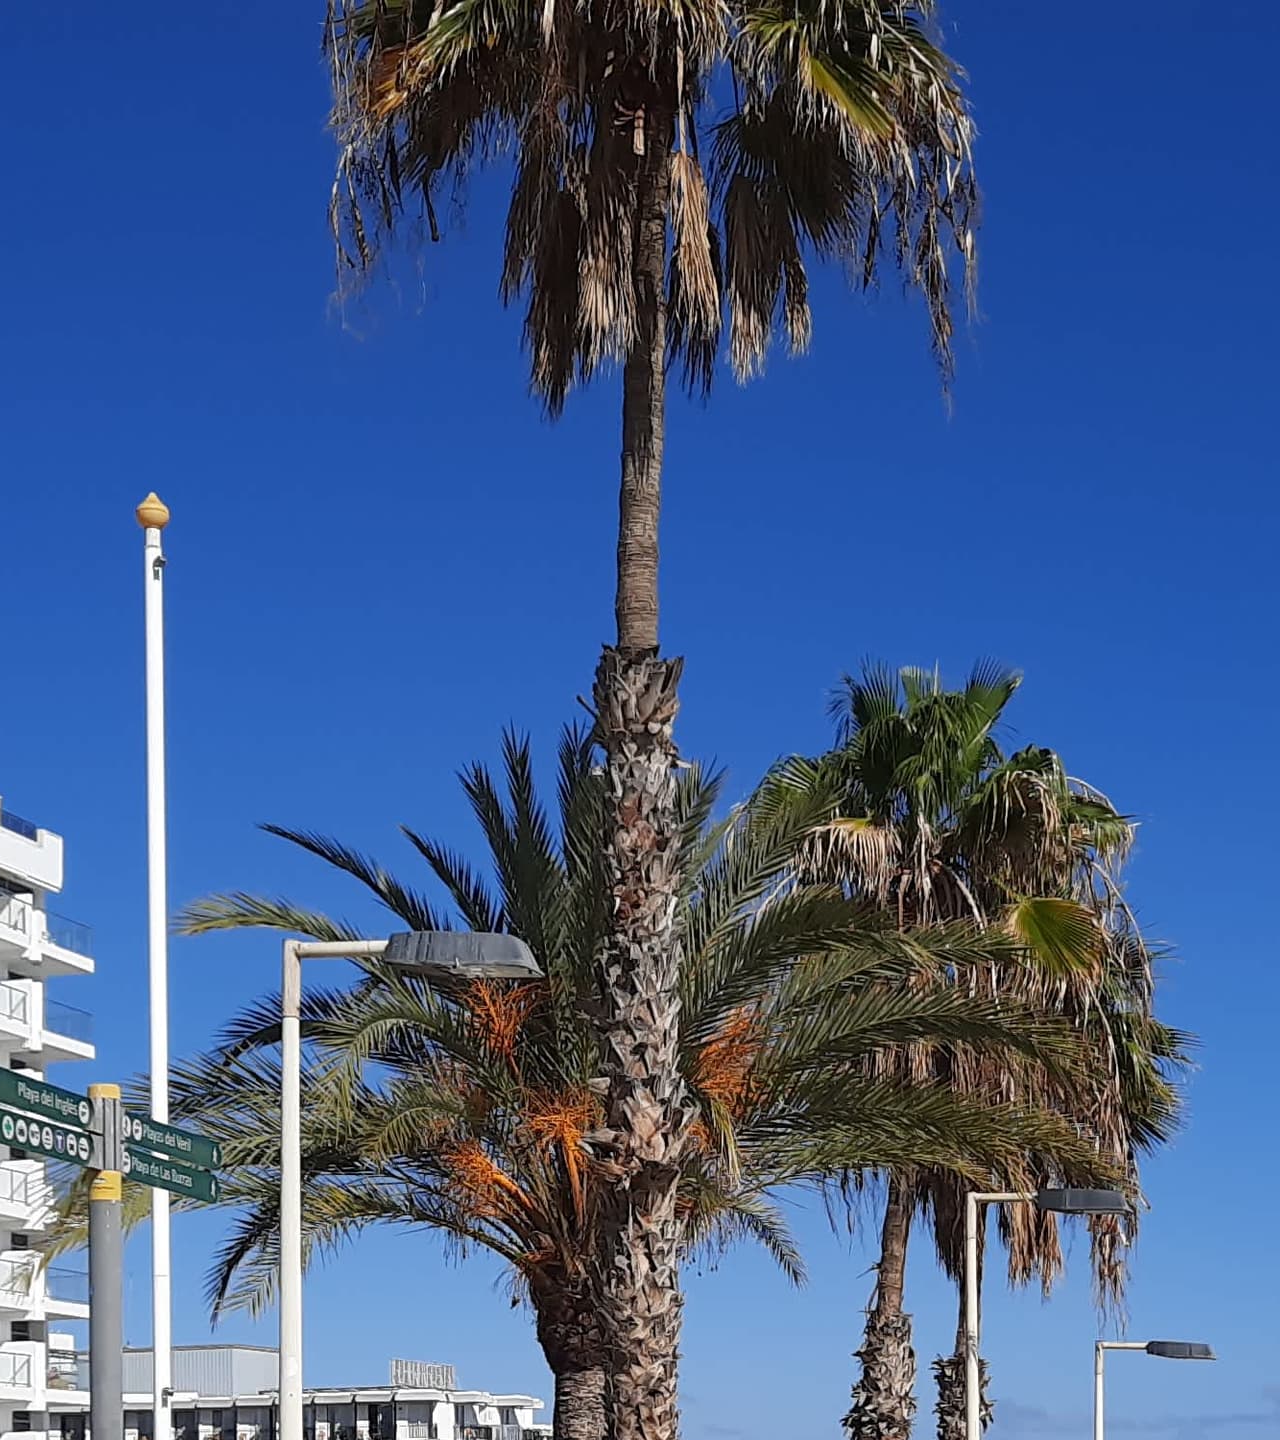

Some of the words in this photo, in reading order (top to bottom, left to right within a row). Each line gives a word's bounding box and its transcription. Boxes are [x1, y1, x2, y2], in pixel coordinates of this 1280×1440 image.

[18, 1081, 40, 1104] Playa
[40, 1090, 54, 1107] del
[132, 1156, 149, 1175] Playa
